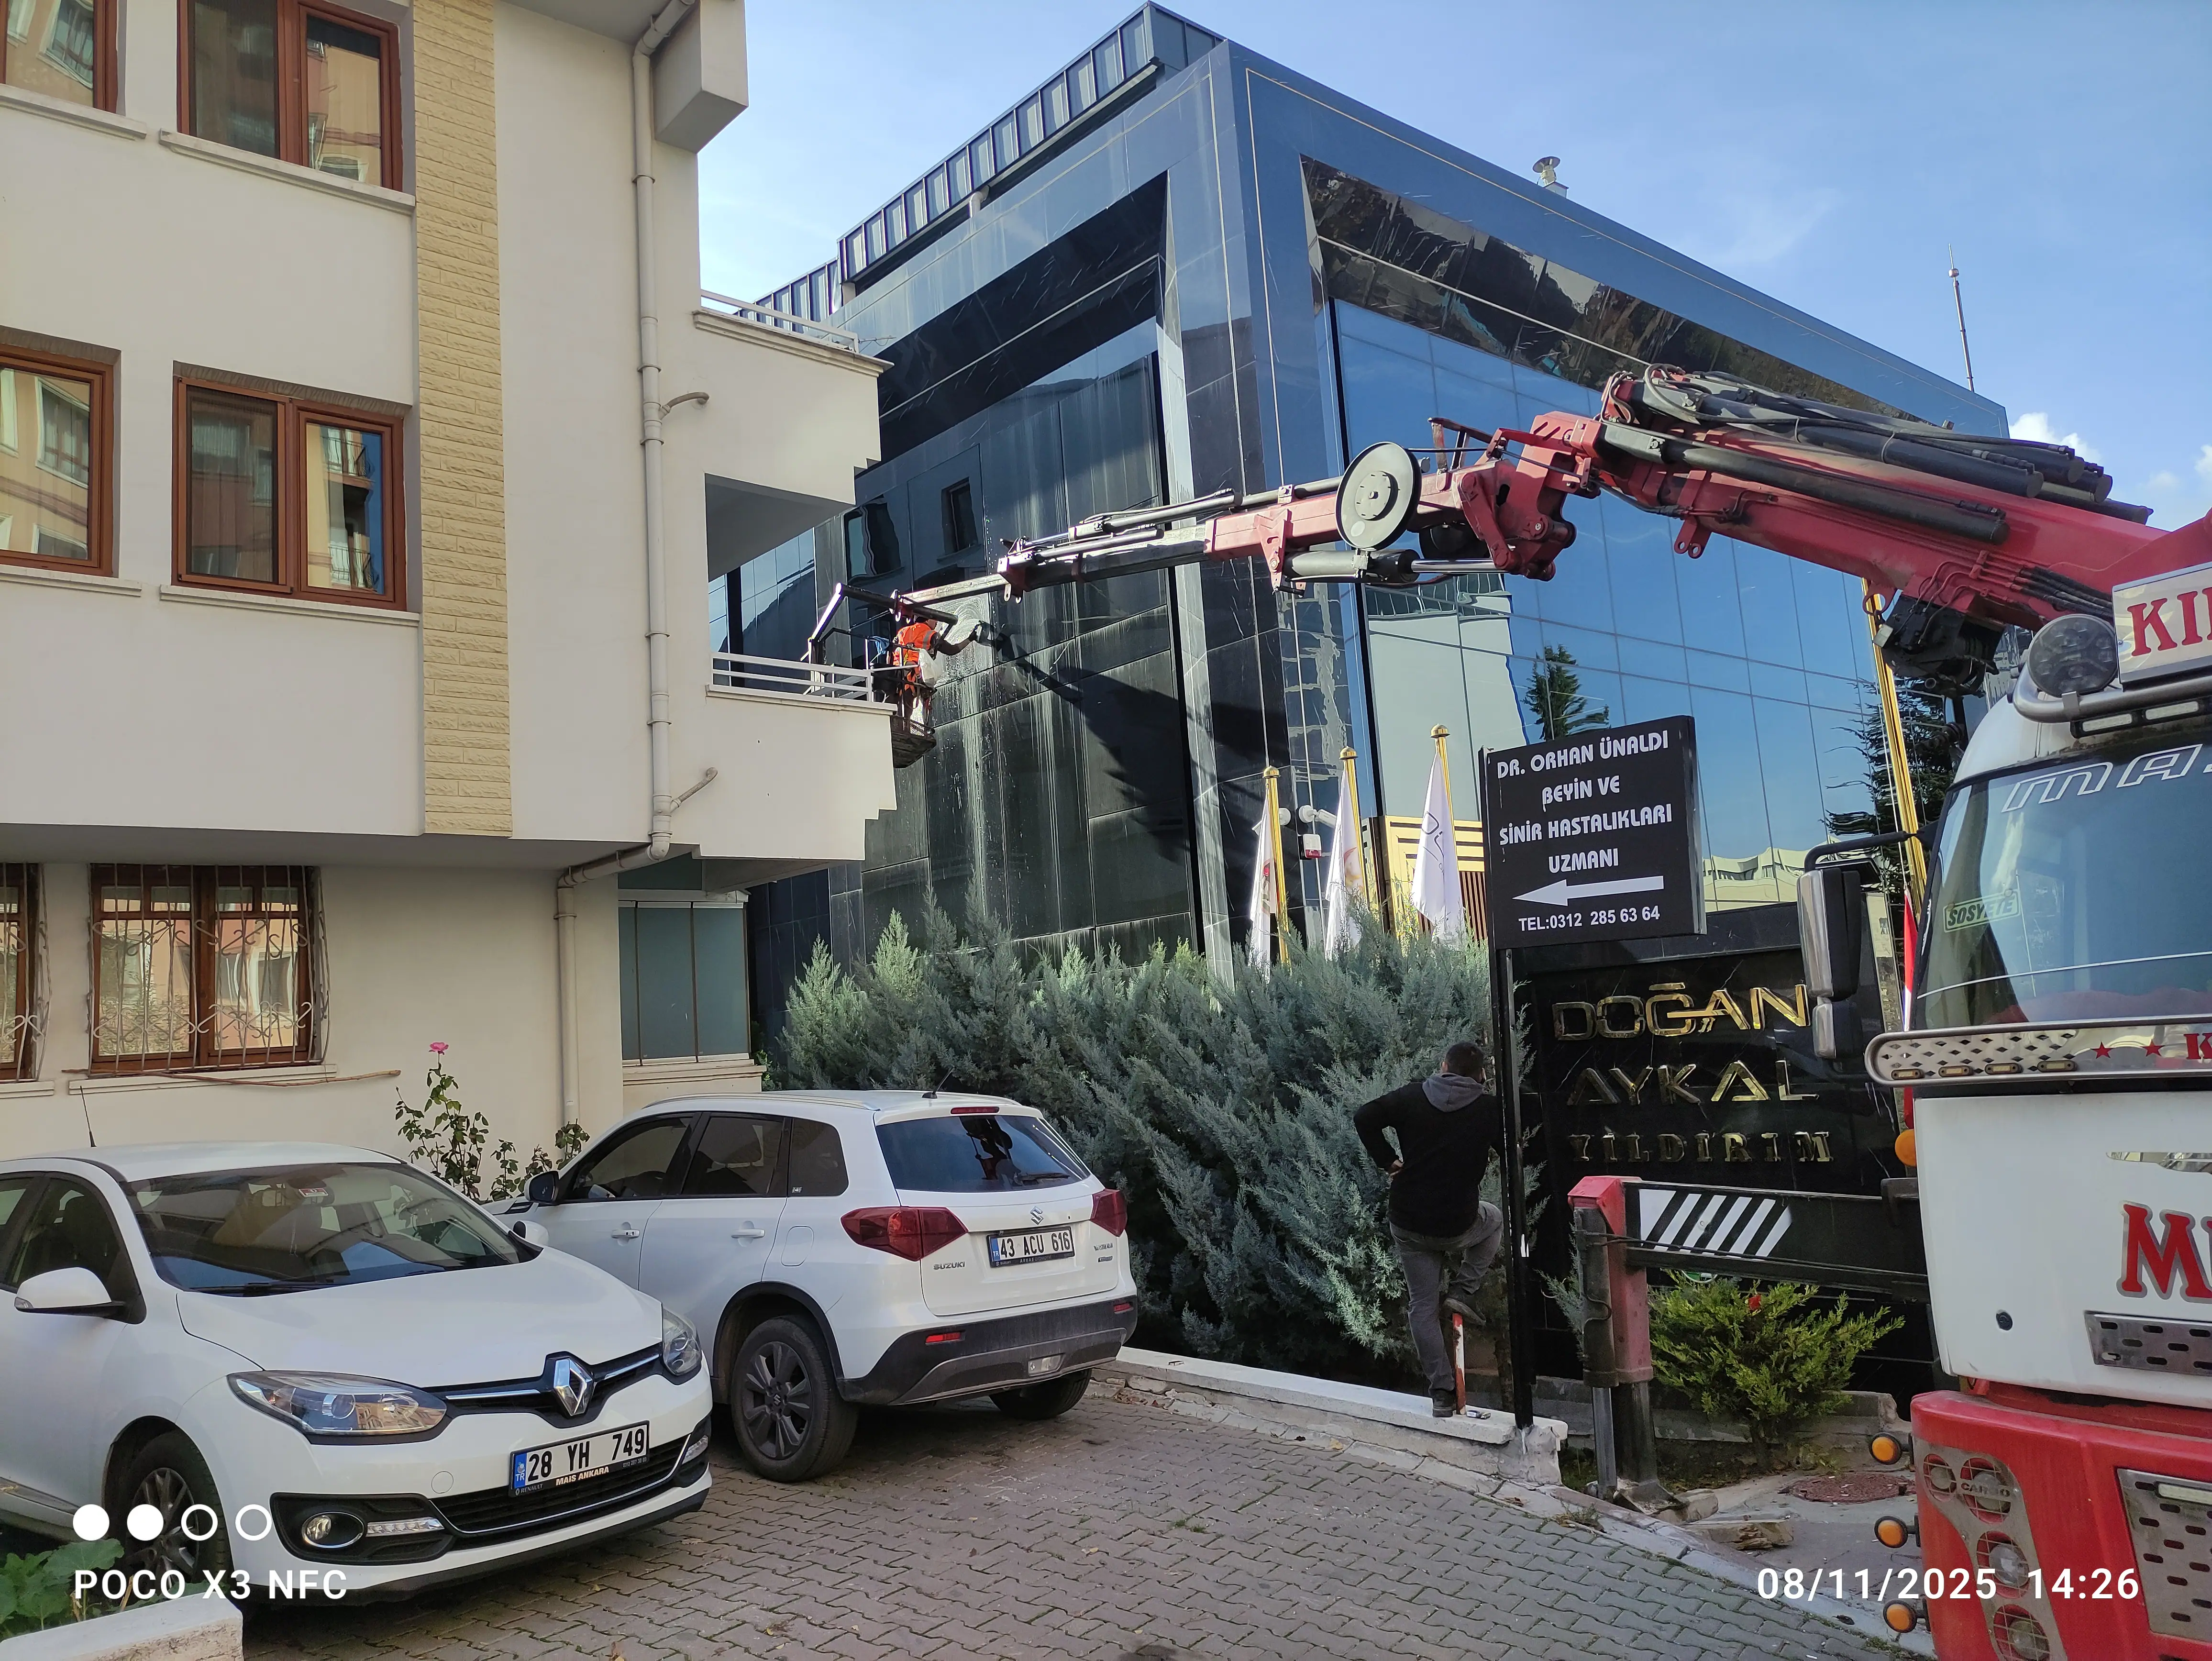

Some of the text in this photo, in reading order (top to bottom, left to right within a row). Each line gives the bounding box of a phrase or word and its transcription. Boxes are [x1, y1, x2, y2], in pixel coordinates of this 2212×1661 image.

[1497, 730, 1669, 779] DR. ORHAN ÜNALDI
[1542, 775, 1620, 805] BEYİN VE
[1499, 804, 1672, 846] SİNİR HASTALIKLARI
[1548, 848, 1619, 874] UZMANI
[1518, 906, 1660, 931] TEL:0312 285 63 64
[1552, 982, 1811, 1041] DOĞAN
[1567, 1060, 1819, 1106] AYKAL
[1569, 1130, 1835, 1163] YILDIRIM
[1001, 1232, 1070, 1258] 43 ACU 616
[2118, 1201, 2212, 1301] M
[933, 1261, 965, 1270] SUZUKI
[528, 1428, 645, 1482] 28 YH 749
[515, 1473, 525, 1482] TR
[520, 1484, 543, 1493] RENAULT
[578, 1466, 609, 1481] ANKARA
